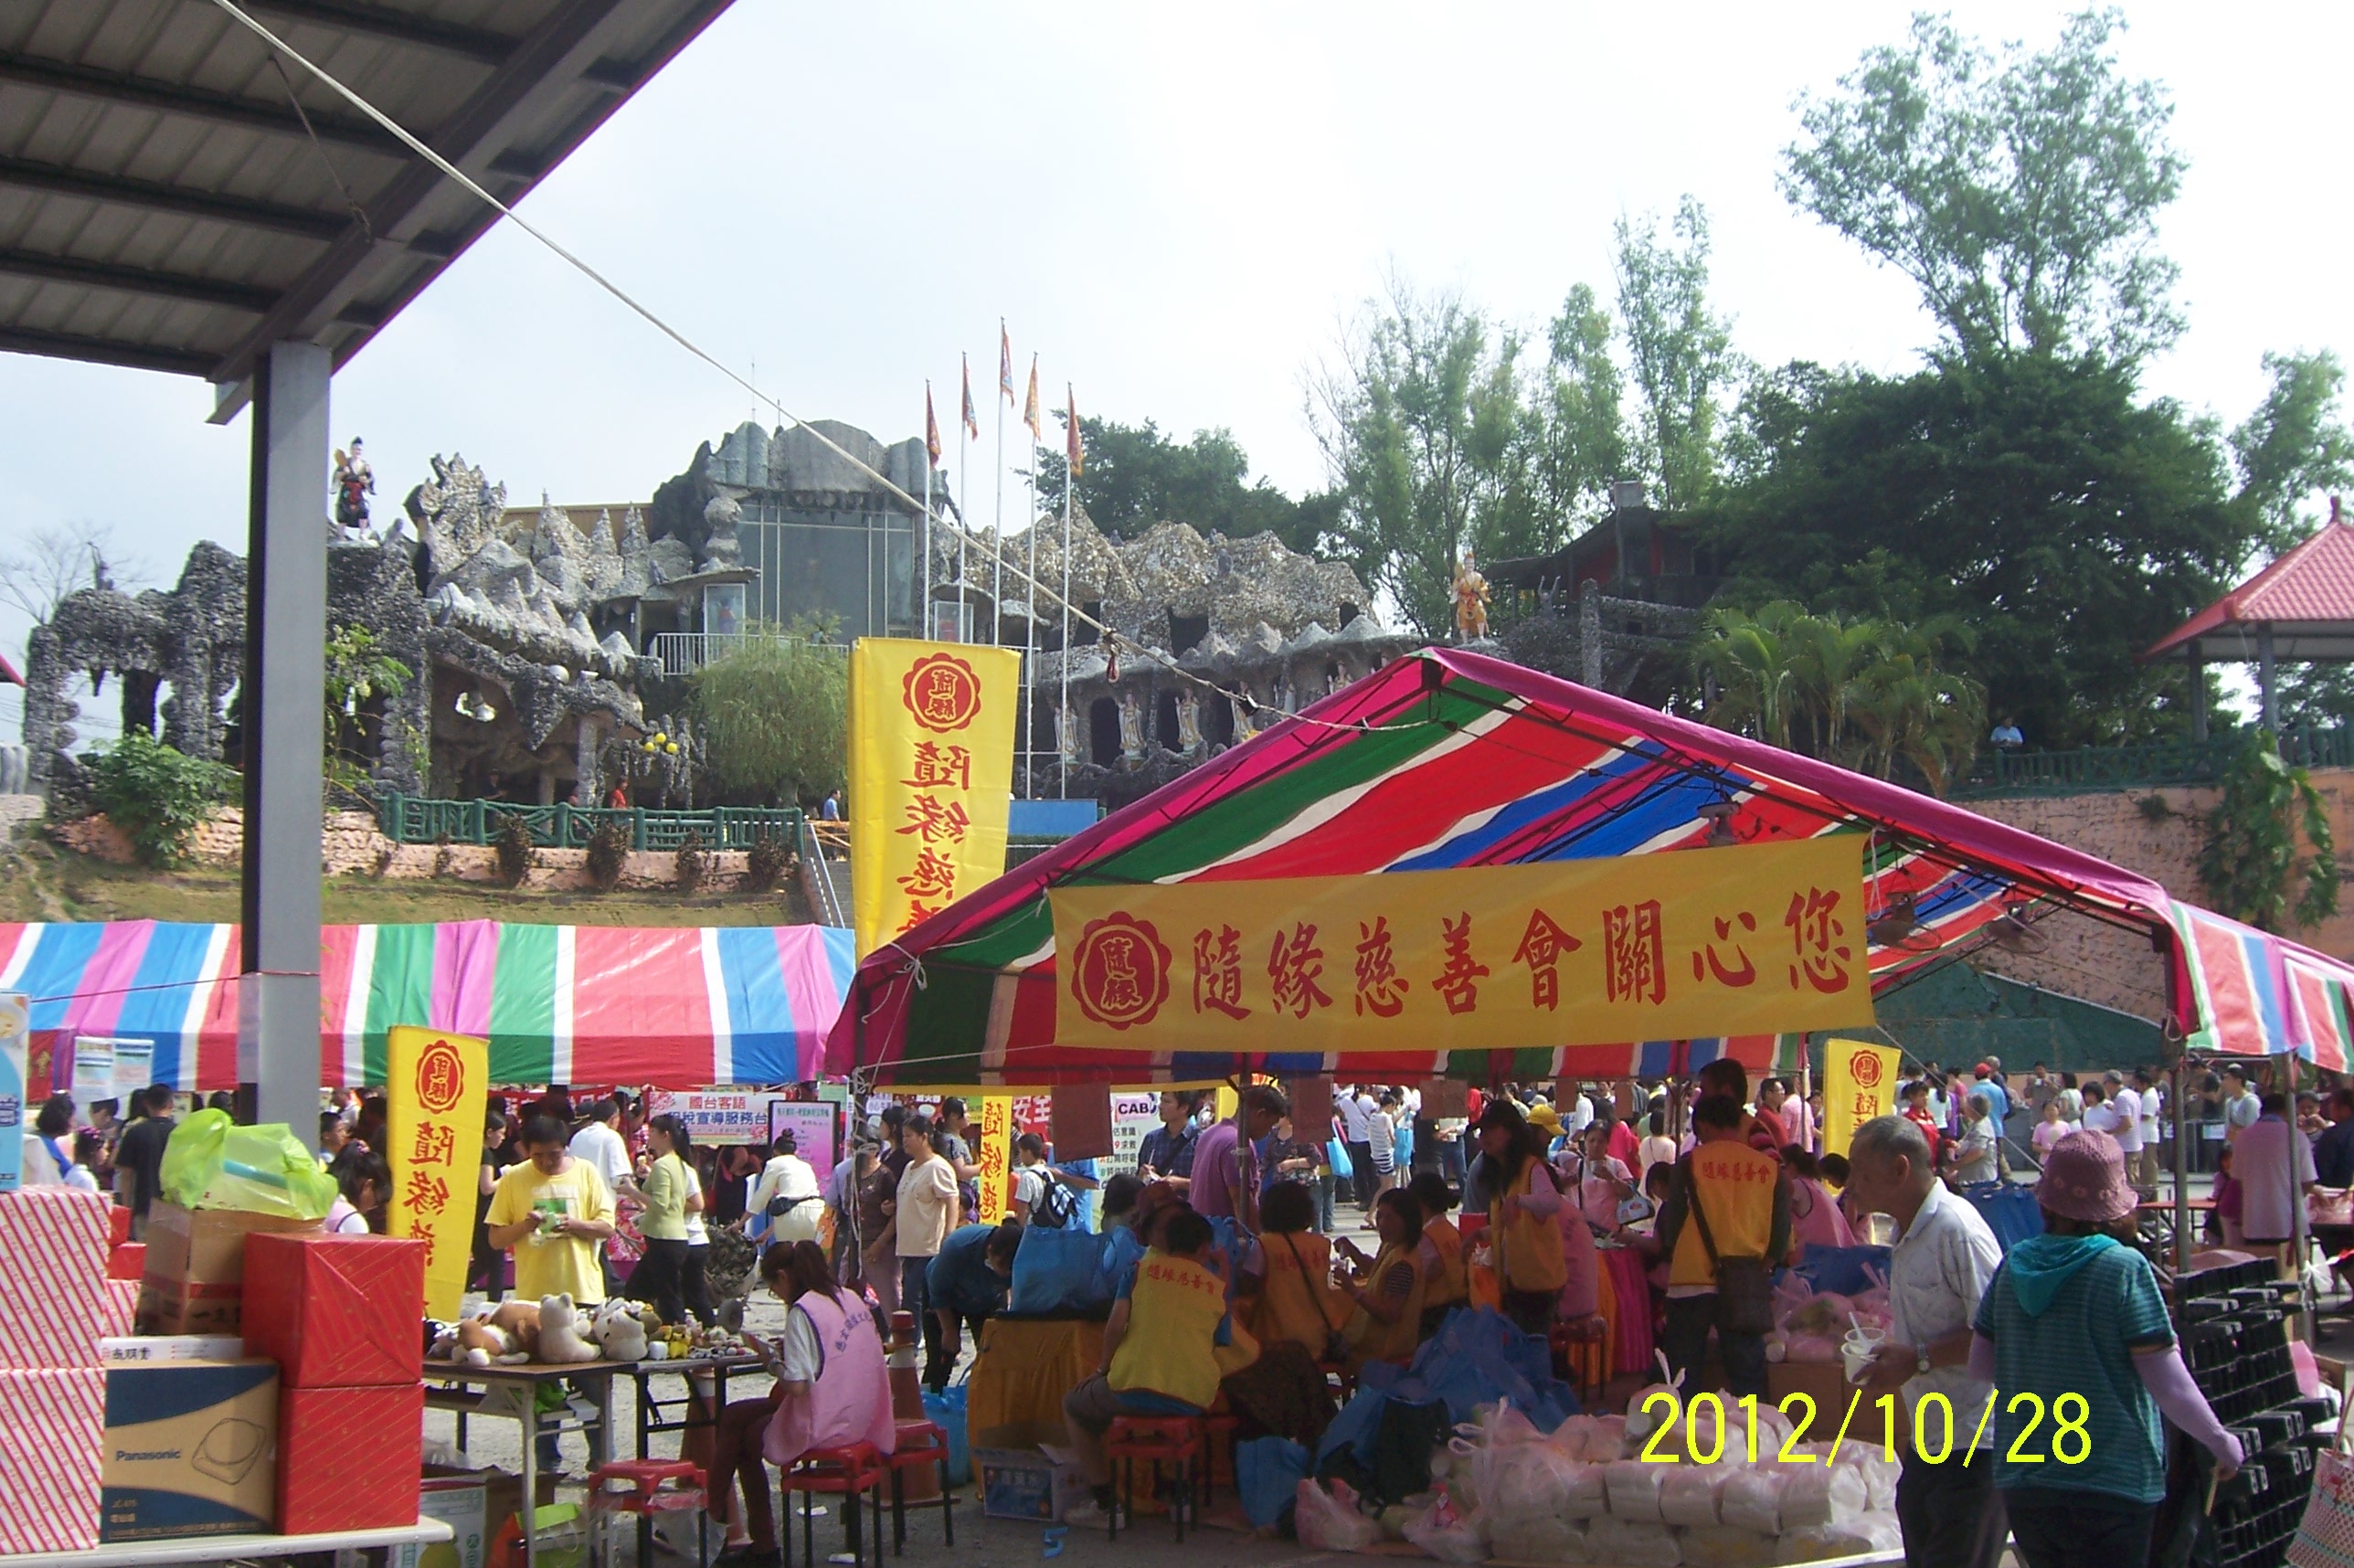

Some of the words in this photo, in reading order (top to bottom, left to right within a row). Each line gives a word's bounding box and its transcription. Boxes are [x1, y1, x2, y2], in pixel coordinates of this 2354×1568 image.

[1193, 885, 1851, 1021] 隨緣慈善會關心您
[689, 1096, 747, 1110] 國台客語
[1118, 1103, 1150, 1116] CAB
[1013, 1096, 1051, 1125] 安全
[116, 1448, 182, 1461] Panasonic
